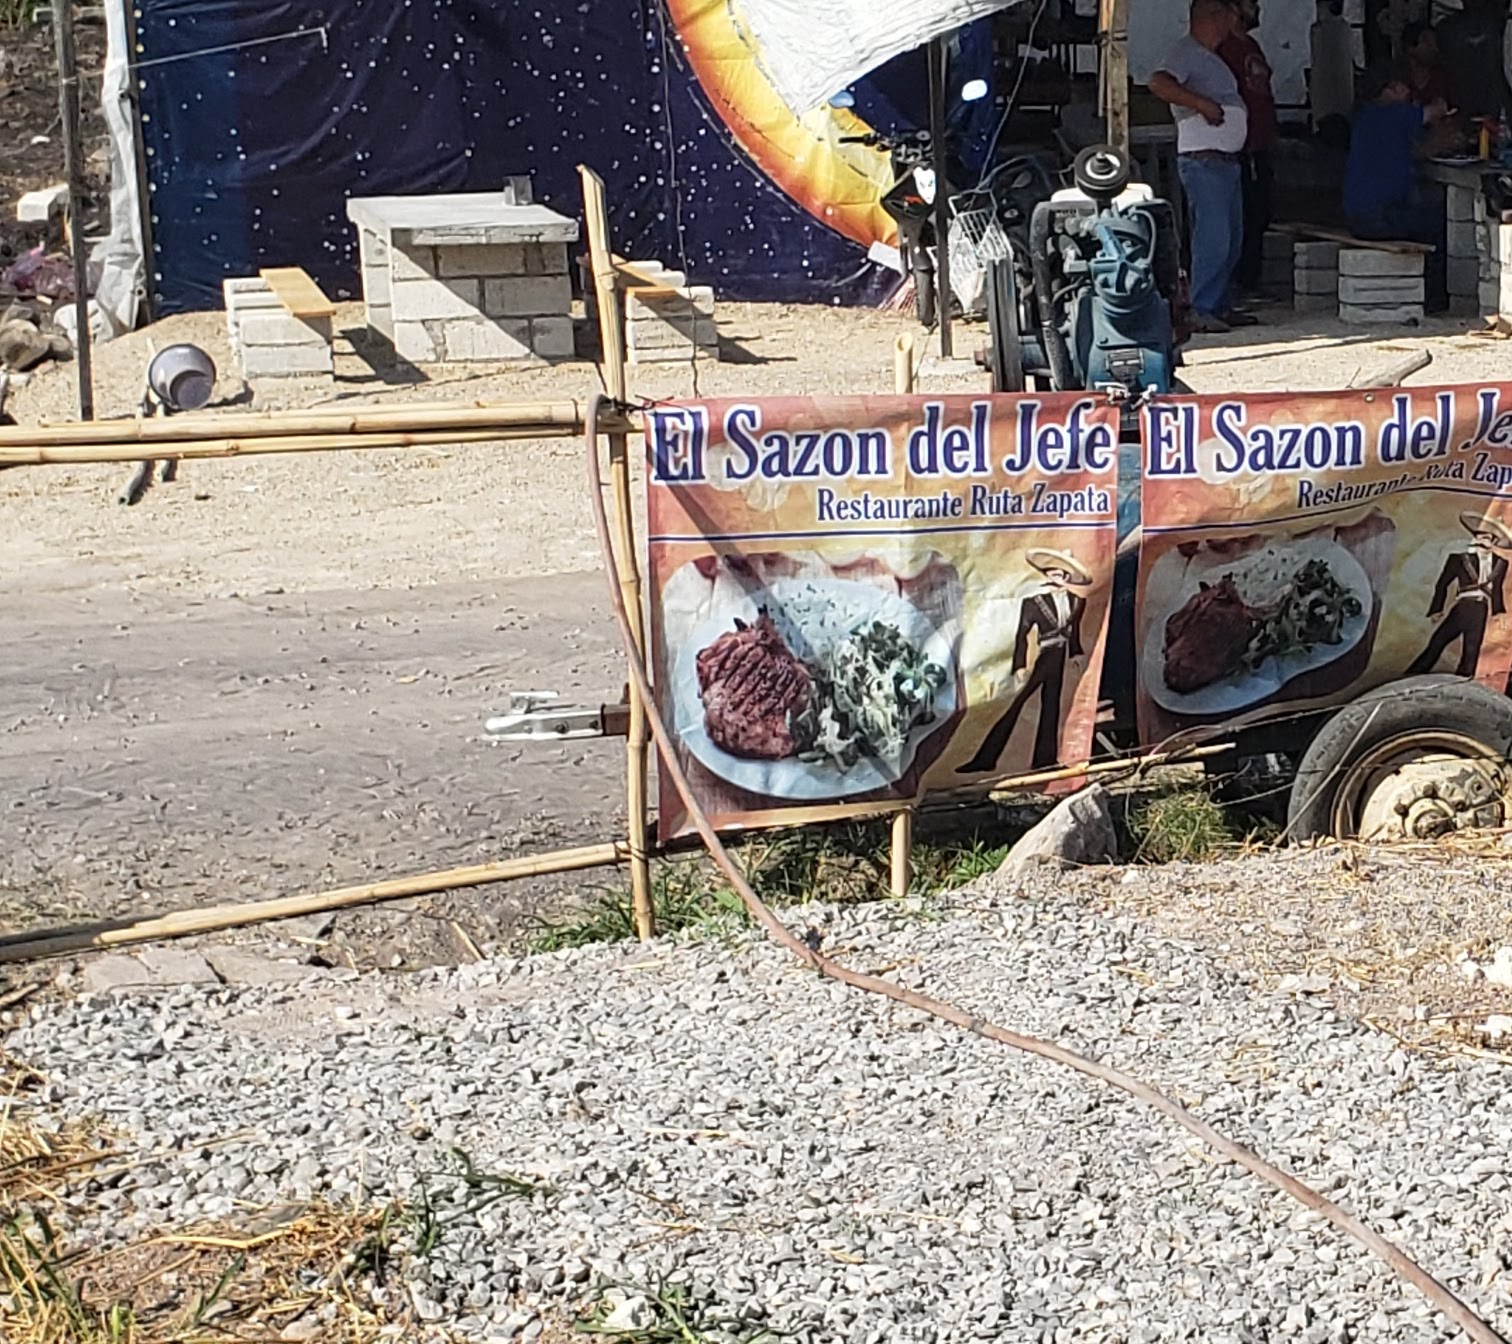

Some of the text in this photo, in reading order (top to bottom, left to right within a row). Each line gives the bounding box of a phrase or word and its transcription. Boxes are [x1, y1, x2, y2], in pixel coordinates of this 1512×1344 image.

[652, 400, 1112, 482] El Sazon del Jefe
[1147, 405, 1198, 476] El
[1214, 403, 1363, 474] Sazon
[1380, 393, 1452, 464] del
[816, 481, 1110, 522] Restaurante Ruta Zapata
